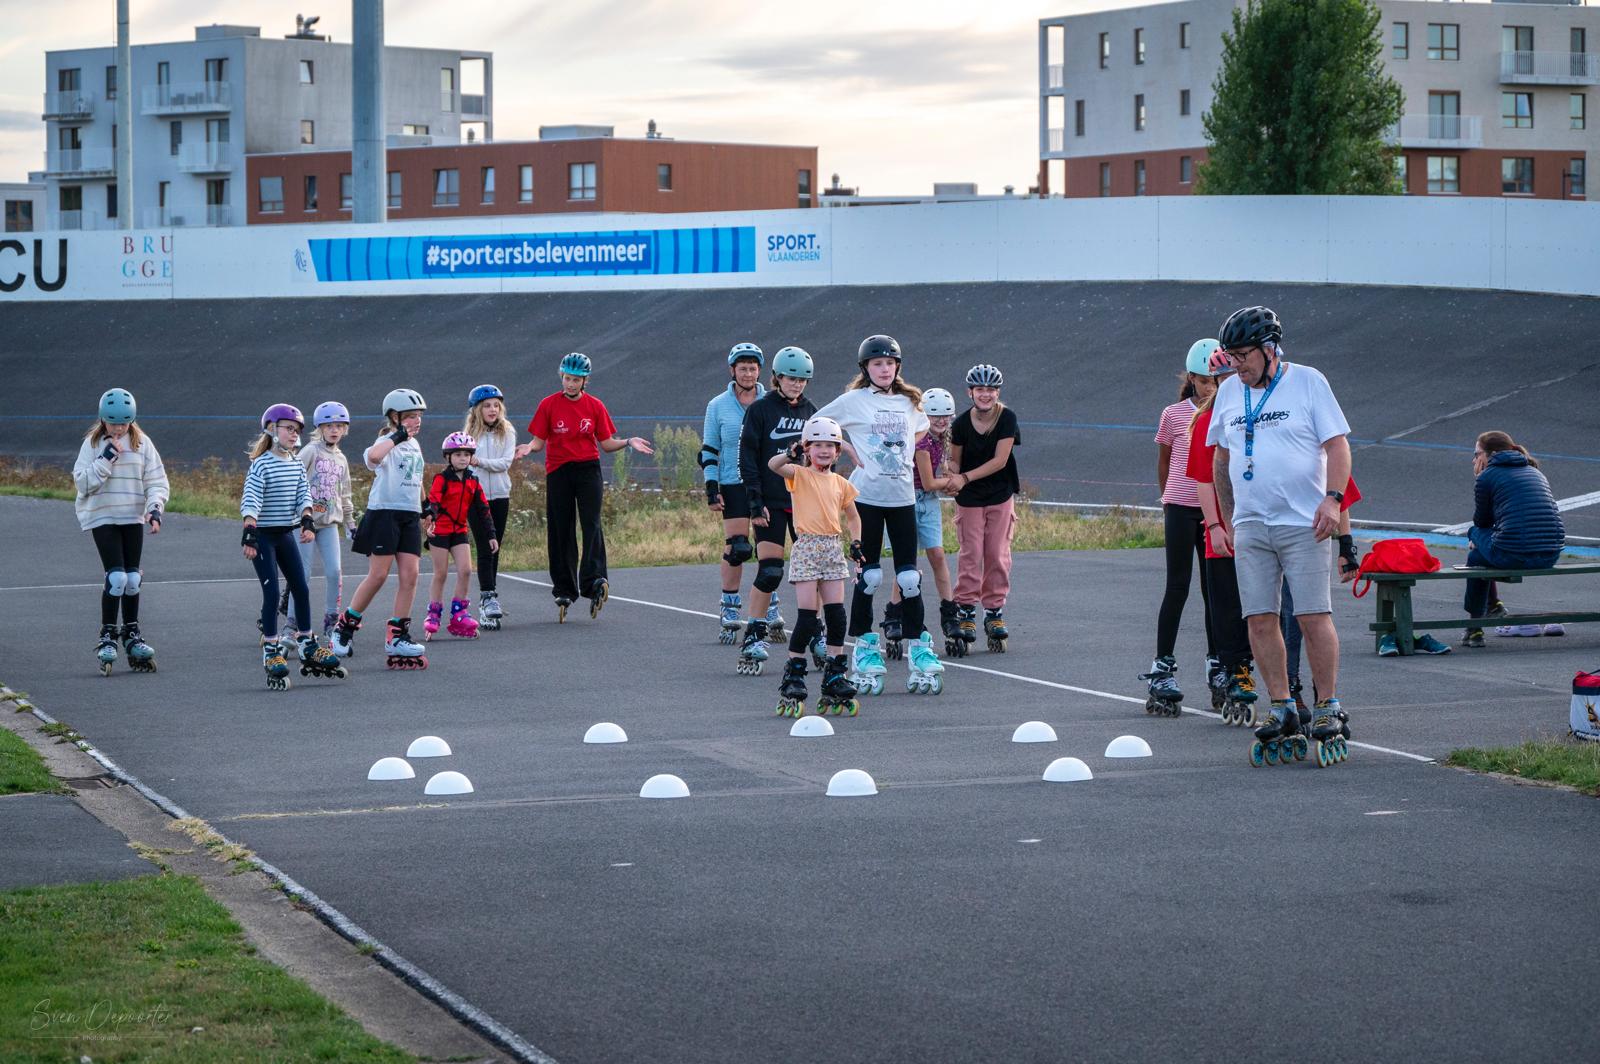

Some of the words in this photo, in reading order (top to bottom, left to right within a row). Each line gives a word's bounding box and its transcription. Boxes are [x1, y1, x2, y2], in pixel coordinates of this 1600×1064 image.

[768, 234, 820, 250] SPORT.
[427, 241, 647, 272] #sportersbelevenmeer
[768, 251, 820, 262] VLAANDEREN
